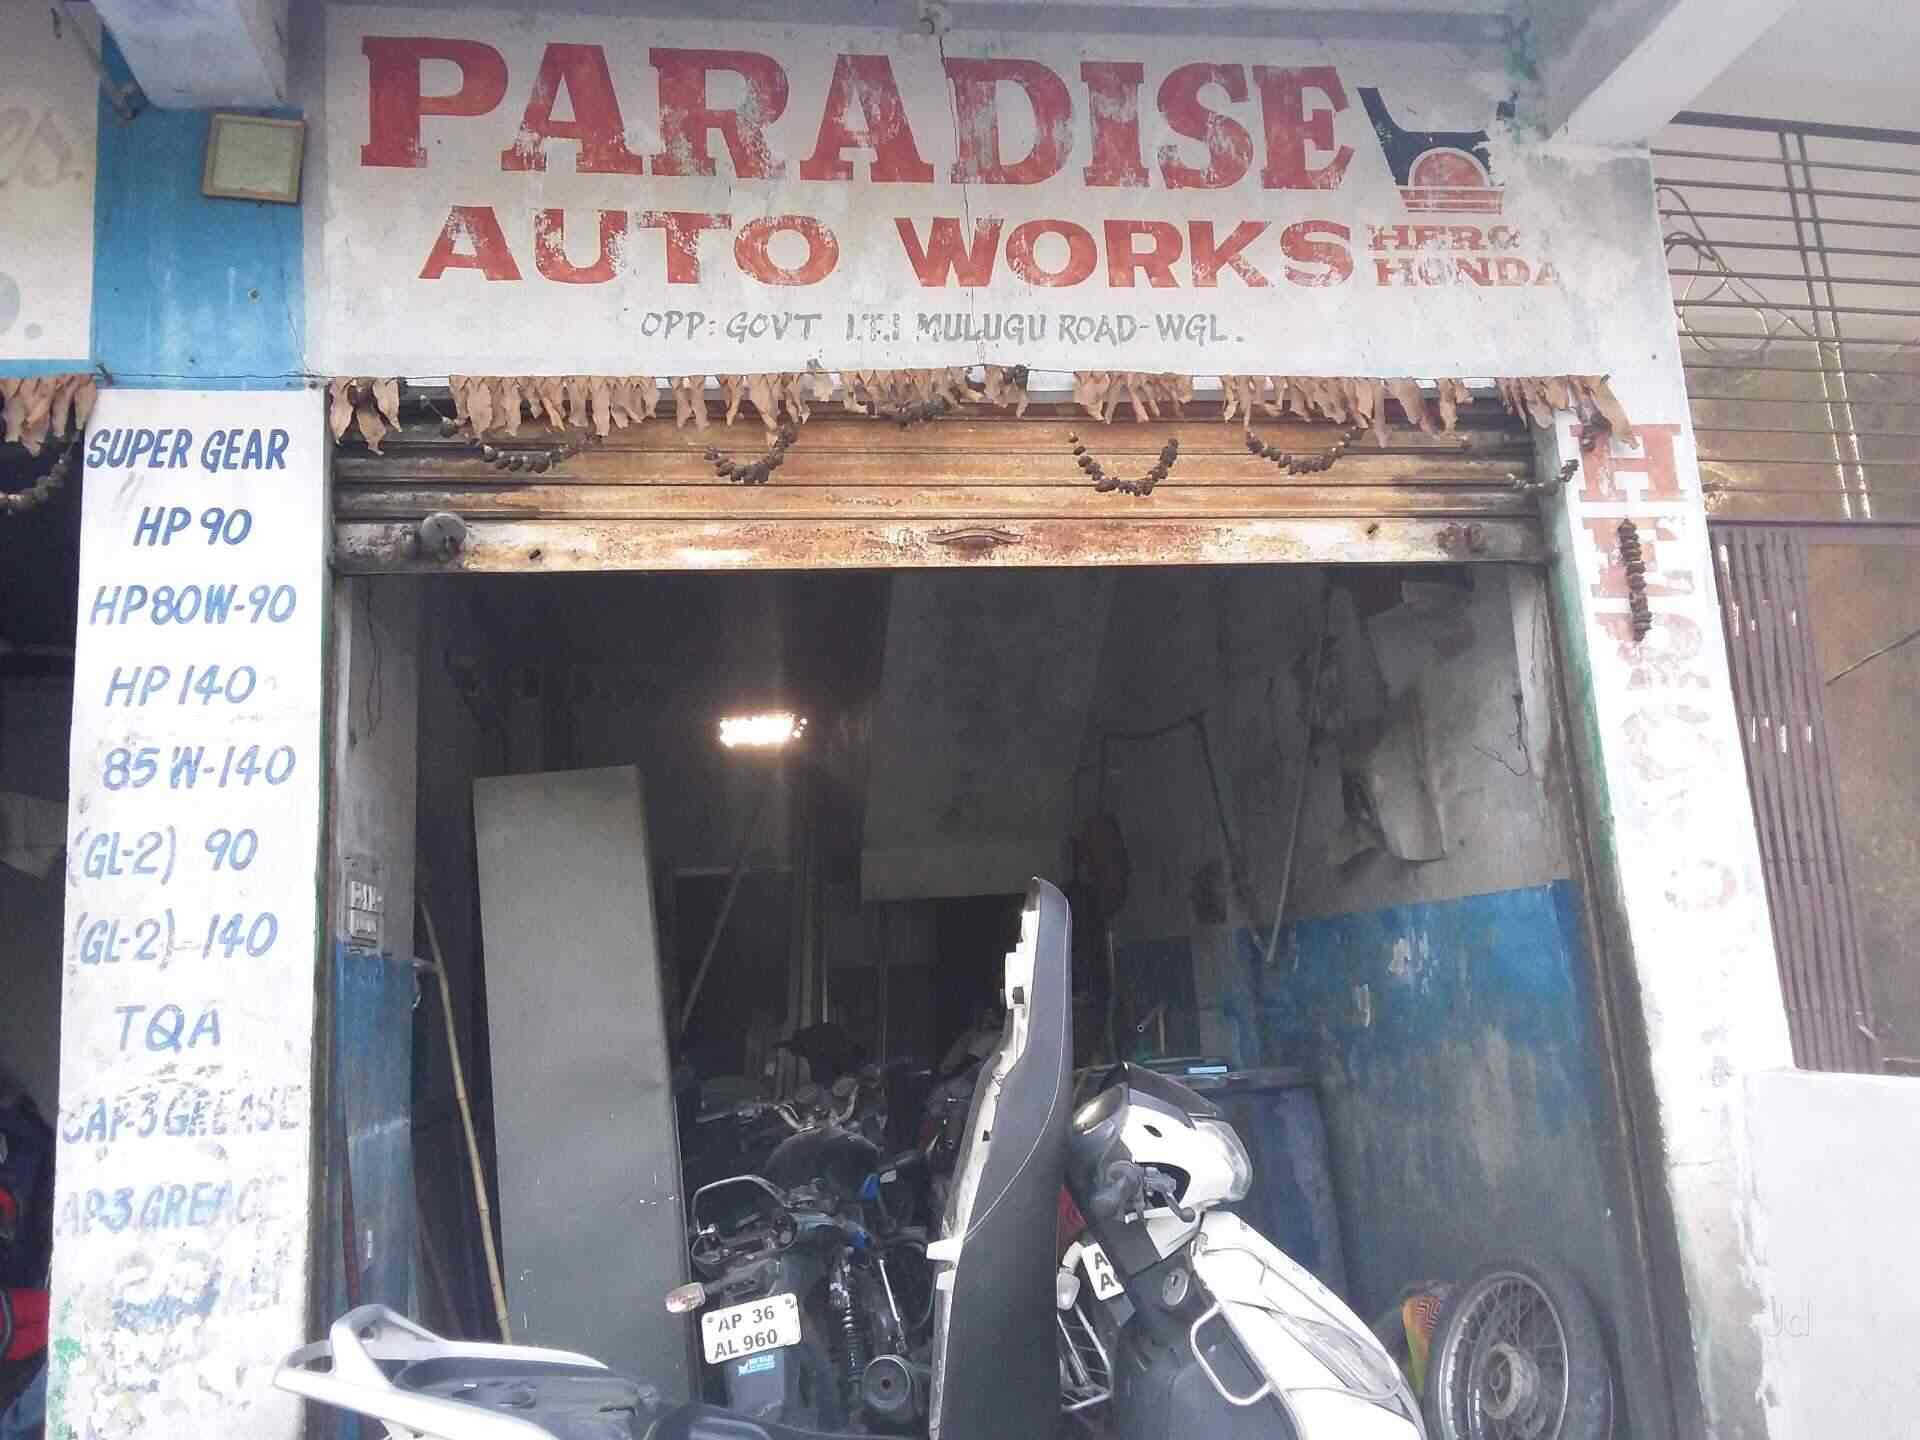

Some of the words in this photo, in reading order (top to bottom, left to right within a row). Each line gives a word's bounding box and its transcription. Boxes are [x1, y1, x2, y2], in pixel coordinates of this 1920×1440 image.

[360, 35, 1356, 191] PARADISE
[418, 204, 840, 286] AUTO
[894, 217, 1356, 289] WORKS
[1373, 256, 1560, 287] HONDA
[640, 310, 716, 340] OPP:
[725, 311, 823, 344] GOVT
[915, 312, 1047, 346] MULUGU
[86, 428, 193, 469] SUPER
[200, 428, 290, 473] GEAR
[133, 506, 192, 547] HP
[200, 507, 252, 546] 90
[104, 665, 171, 707] HP
[177, 664, 257, 706] 140
[204, 828, 258, 871] 90
[115, 1003, 222, 1054] TQA
[717, 1313, 742, 1333] AP
[751, 1305, 775, 1325] 36
[714, 1340, 739, 1359] AL
[743, 1329, 778, 1351] 960
